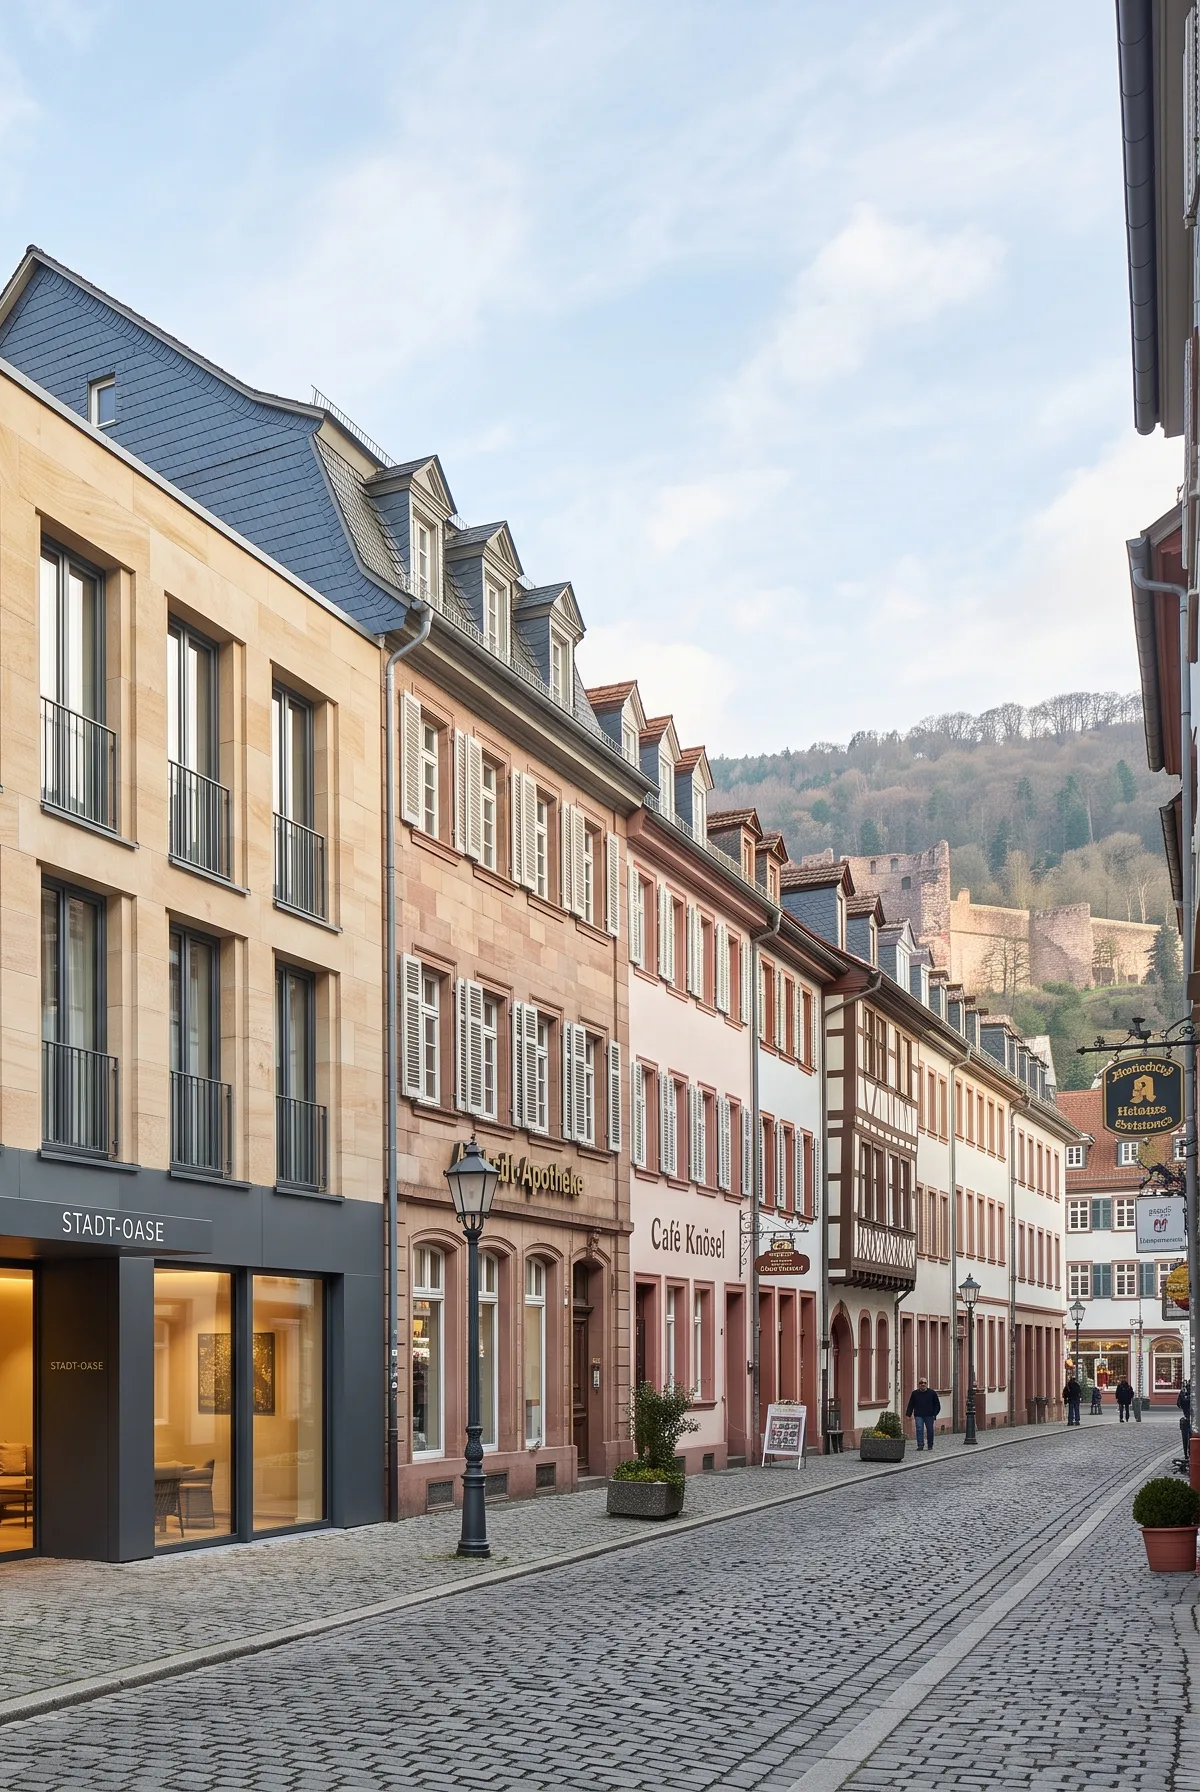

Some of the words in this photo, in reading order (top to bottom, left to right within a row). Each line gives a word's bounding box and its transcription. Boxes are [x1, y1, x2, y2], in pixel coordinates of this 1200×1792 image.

[62, 1211, 164, 1242] STADT-OASE
[651, 1217, 681, 1253] Café
[685, 1223, 725, 1259] Knösel
[50, 1361, 104, 1370] STADT-OASE
